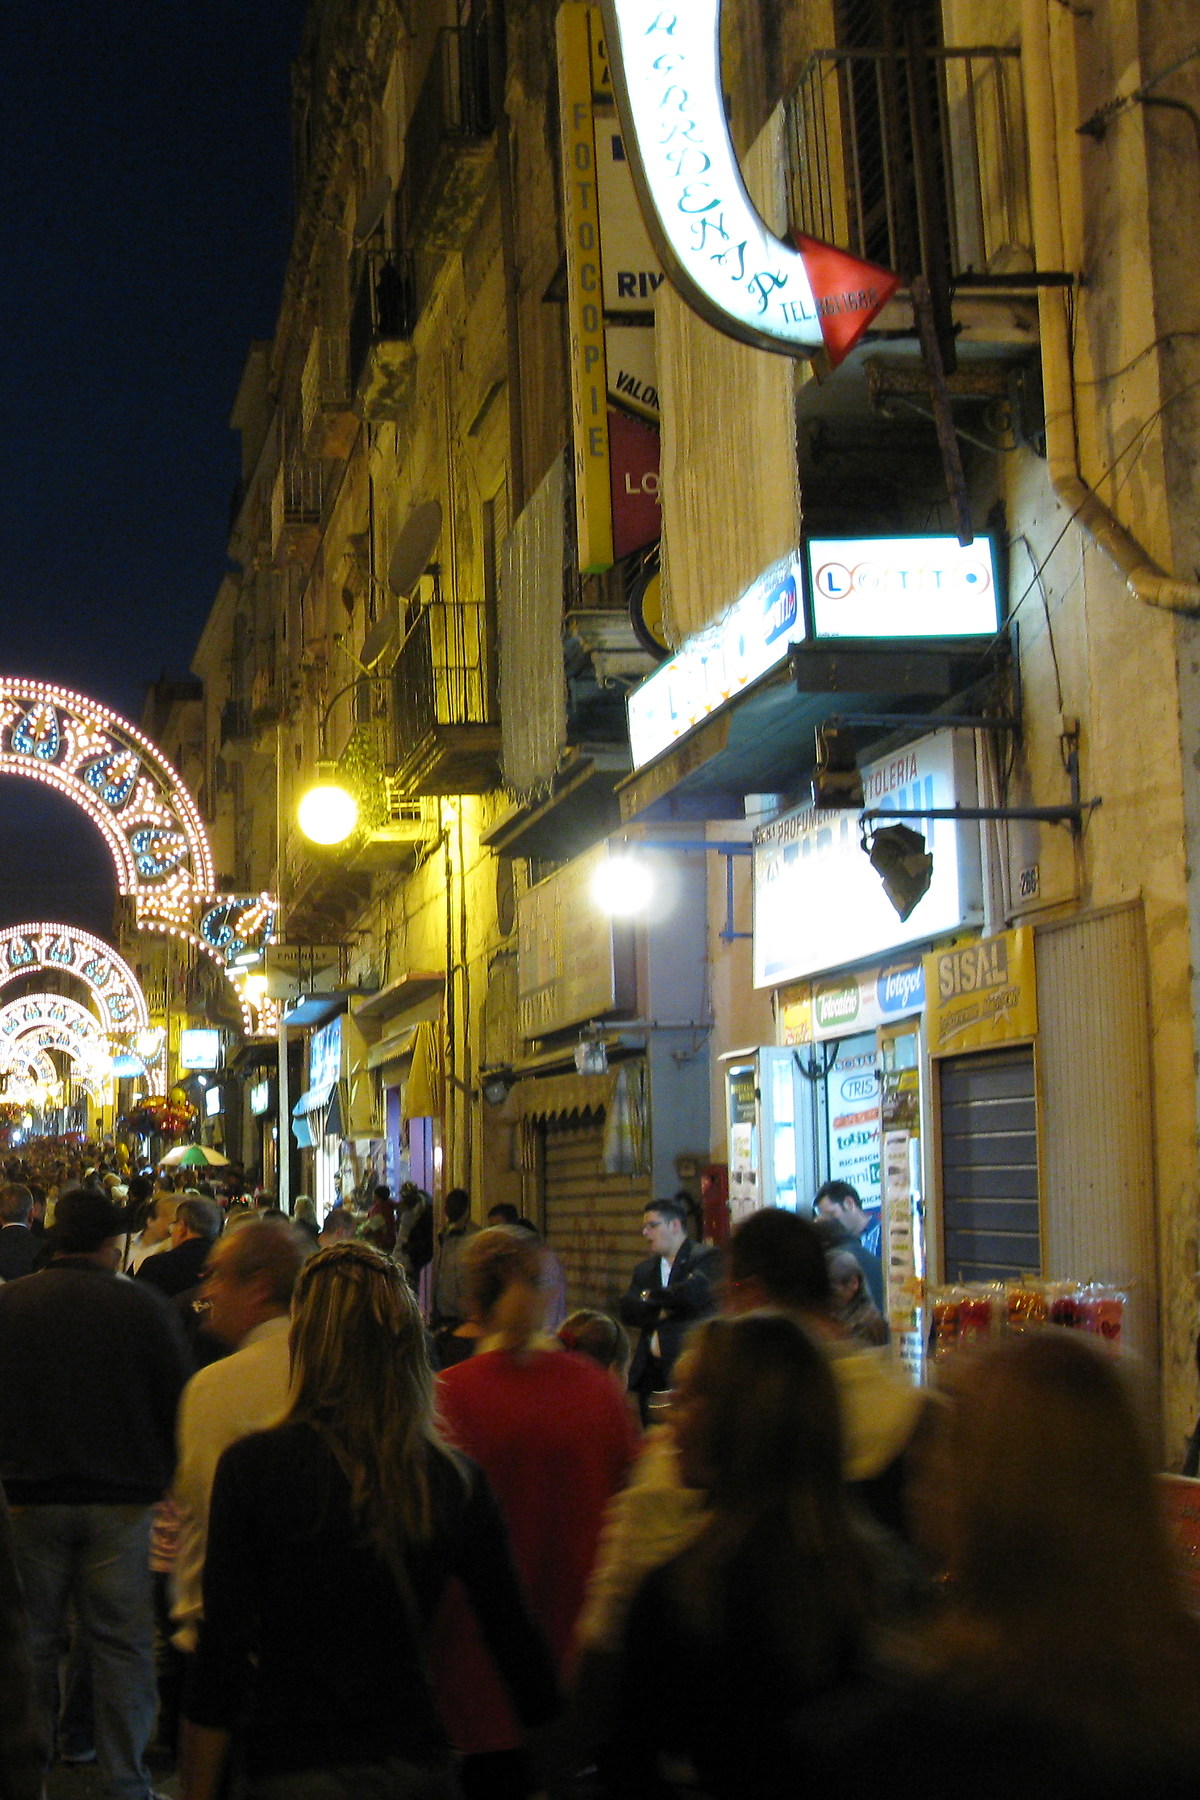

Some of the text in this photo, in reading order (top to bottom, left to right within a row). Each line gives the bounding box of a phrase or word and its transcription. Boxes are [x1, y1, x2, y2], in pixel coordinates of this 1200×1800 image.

[573, 103, 604, 457] FOTOCOPIE
[865, 752, 918, 800] TOLERIA
[938, 943, 1008, 998] SISAL
[848, 1079, 874, 1098] TRIS
